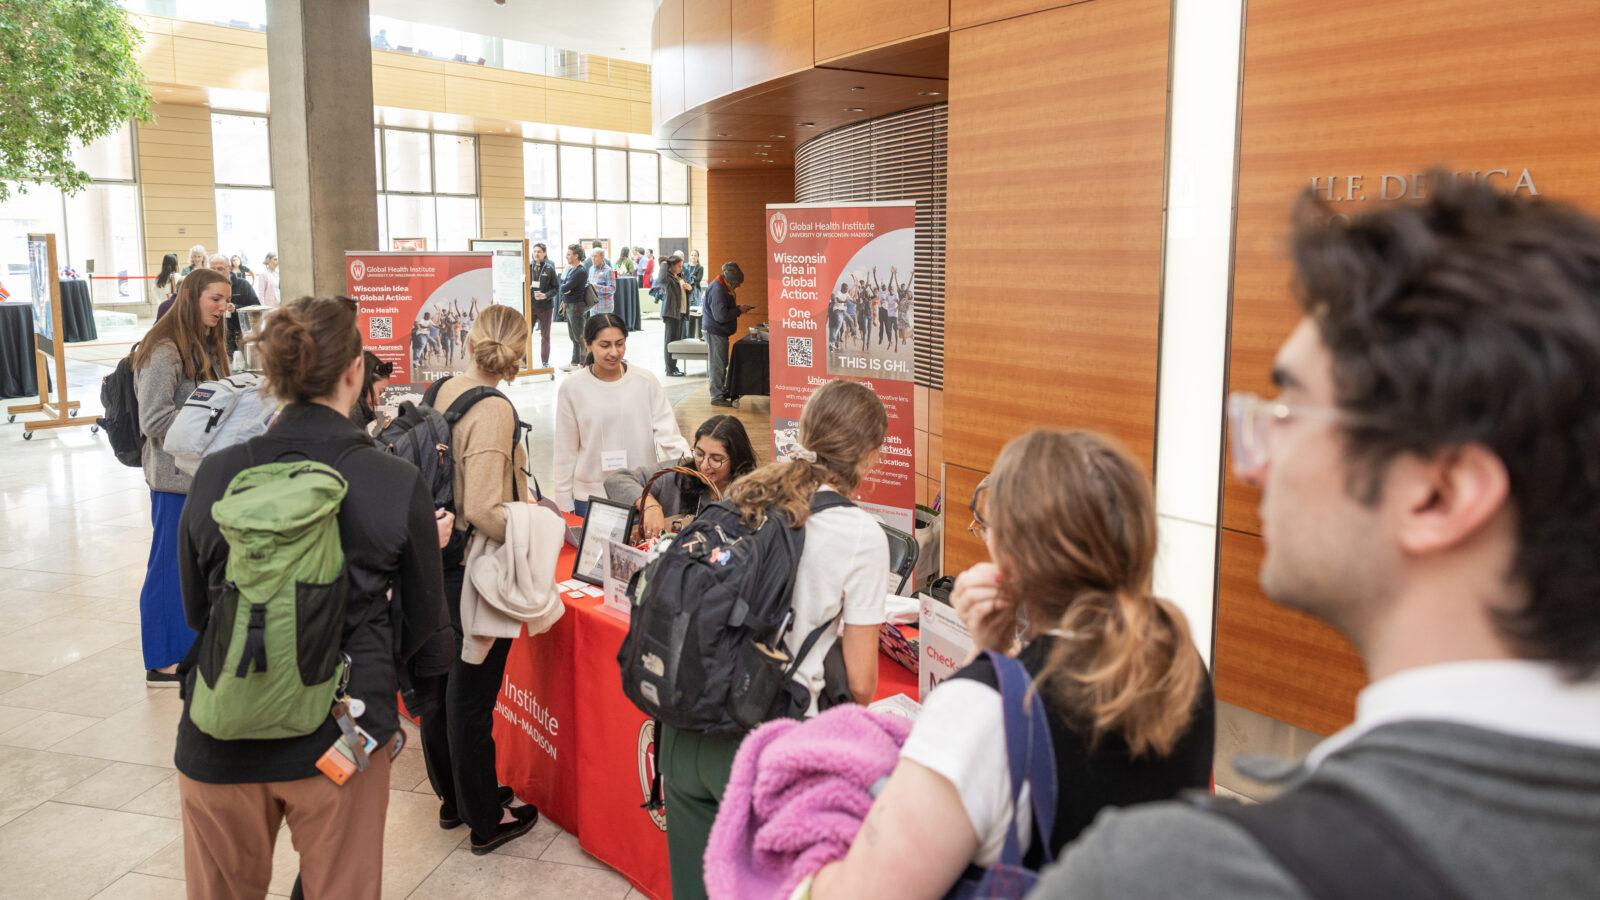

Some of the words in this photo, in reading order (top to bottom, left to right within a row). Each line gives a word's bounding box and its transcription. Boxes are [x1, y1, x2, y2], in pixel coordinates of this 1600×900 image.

[1311, 175, 1366, 202] H.F.
[1380, 168, 1539, 201] DEUCA
[789, 221, 812, 230] Global
[815, 221, 840, 230] Health
[842, 221, 875, 230] Institute
[774, 252, 826, 264] Wisconsin
[782, 264, 804, 274] Idea
[807, 264, 816, 274] in
[782, 276, 816, 288] Global
[780, 288, 818, 300] Action:
[788, 308, 810, 318] One
[782, 318, 817, 330] Health
[839, 356, 866, 370] THIS
[869, 358, 881, 370] IS
[883, 359, 909, 373] GHI.
[883, 436, 902, 445] ealth
[879, 458, 910, 468] Locations
[926, 646, 960, 672] Check-
[505, 674, 559, 736] Institute
[494, 700, 557, 760] NSIN-MADISON
